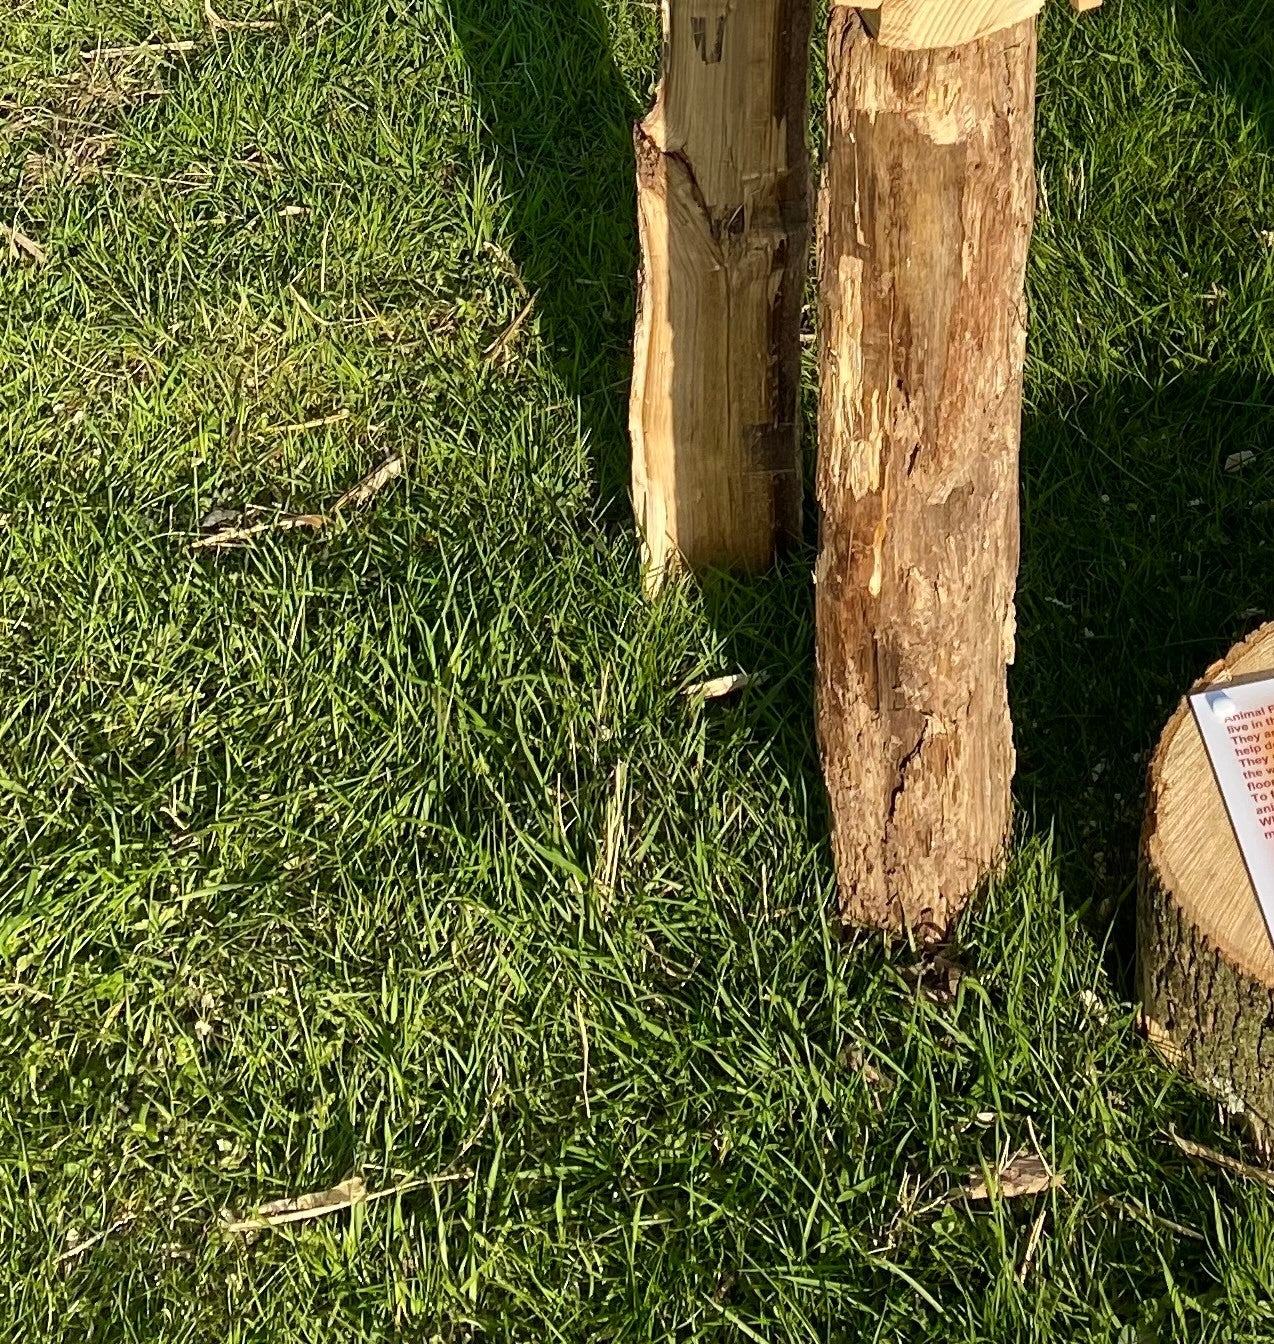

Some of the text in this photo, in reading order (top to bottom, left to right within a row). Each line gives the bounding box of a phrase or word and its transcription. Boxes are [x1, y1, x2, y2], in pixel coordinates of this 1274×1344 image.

[1227, 723, 1249, 734] live
[1251, 721, 1263, 729] in
[1231, 732, 1260, 745] They
[1235, 744, 1261, 757] help
[1238, 755, 1268, 768] They
[1243, 769, 1263, 779] the
[1251, 792, 1268, 803] To
